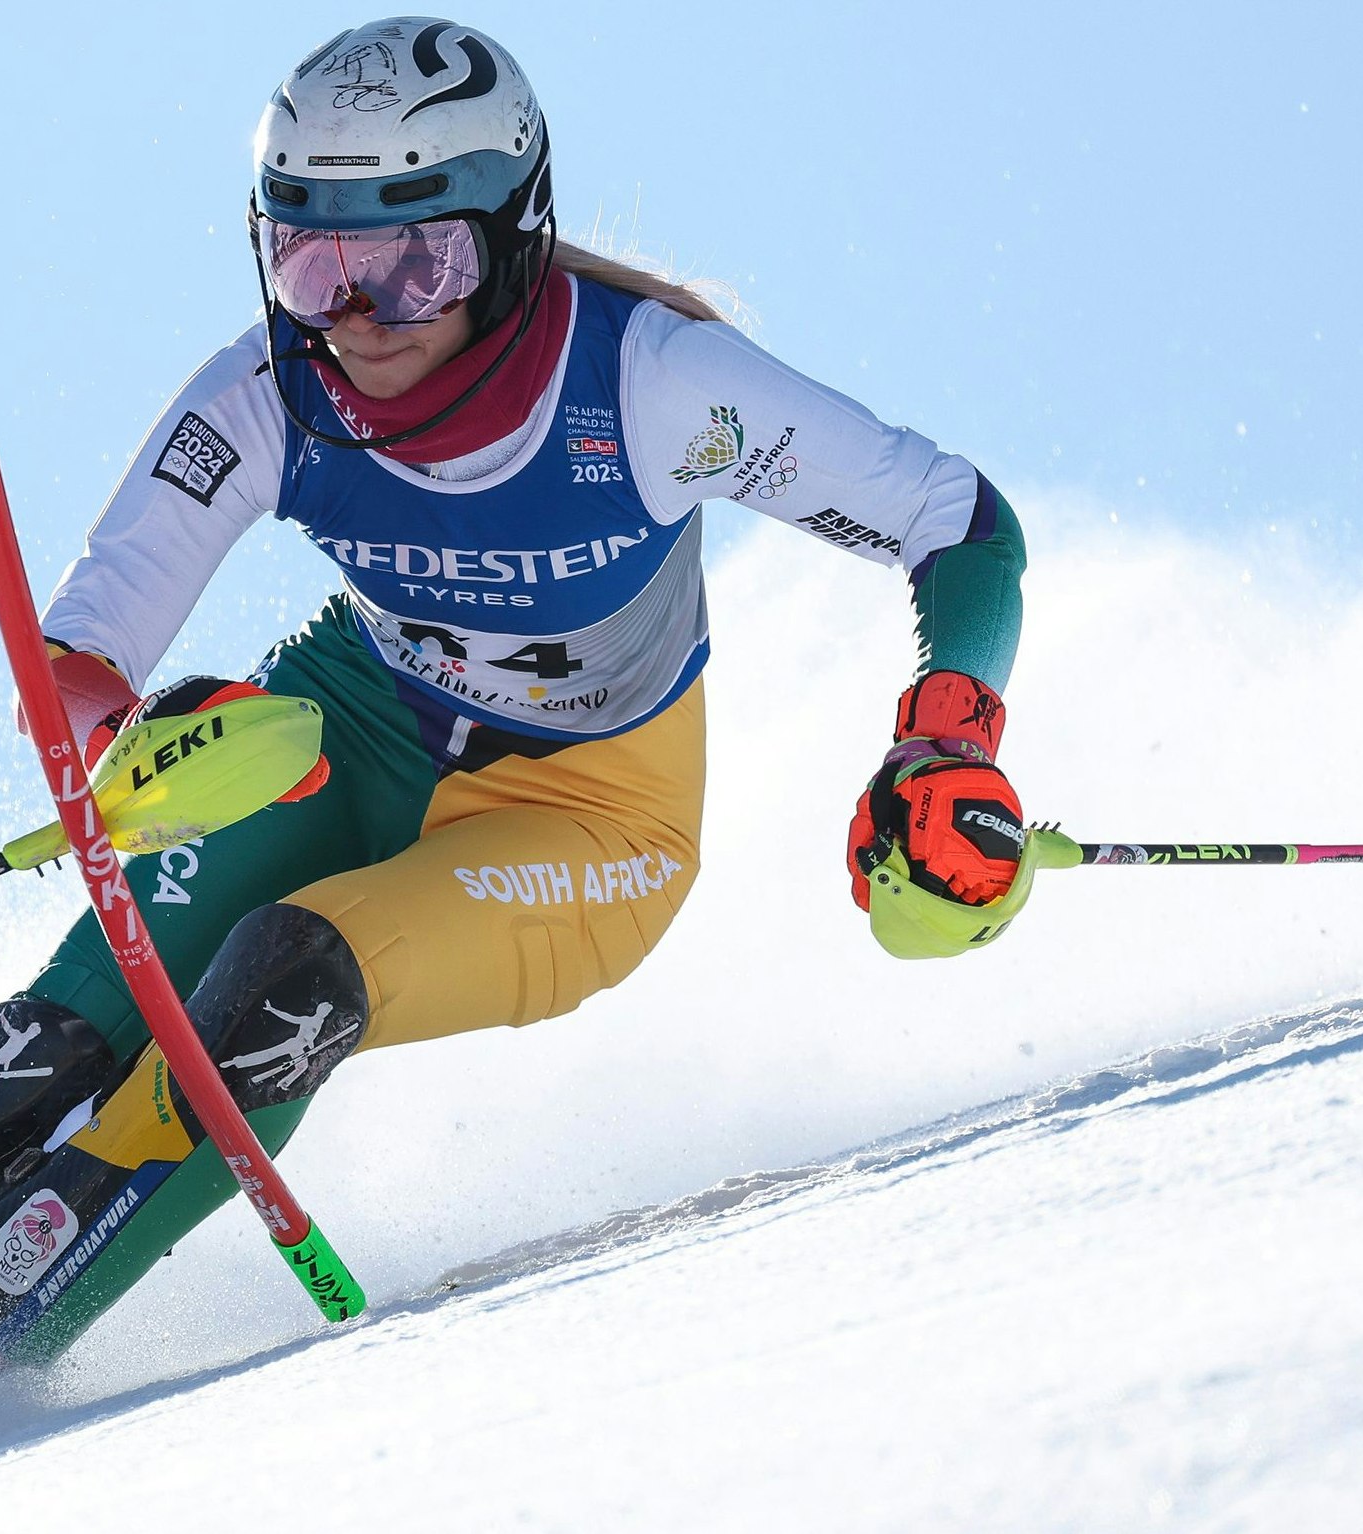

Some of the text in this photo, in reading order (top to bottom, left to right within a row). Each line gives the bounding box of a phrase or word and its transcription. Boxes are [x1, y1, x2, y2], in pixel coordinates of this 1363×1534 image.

[332, 157, 379, 165] MARKTHALER
[565, 405, 614, 419] FIS ALPINE
[566, 417, 614, 430] WORLD SKI
[172, 429, 224, 476] 2024
[182, 416, 234, 464] GANGWON
[759, 426, 796, 474] AFRICA
[571, 463, 623, 483] 2025
[734, 447, 764, 481] TEAM
[320, 527, 649, 583] REDESTEIN
[399, 583, 535, 607] TYRES
[48, 740, 72, 759] C6
[132, 715, 224, 791] LEKI
[915, 786, 933, 831] racing
[1172, 845, 1251, 860] LEKI
[453, 848, 682, 906] SOUTH AFRICA
[37, 1187, 139, 1308] ENERGIAPURA
[15, 1271, 28, 1284] IT
